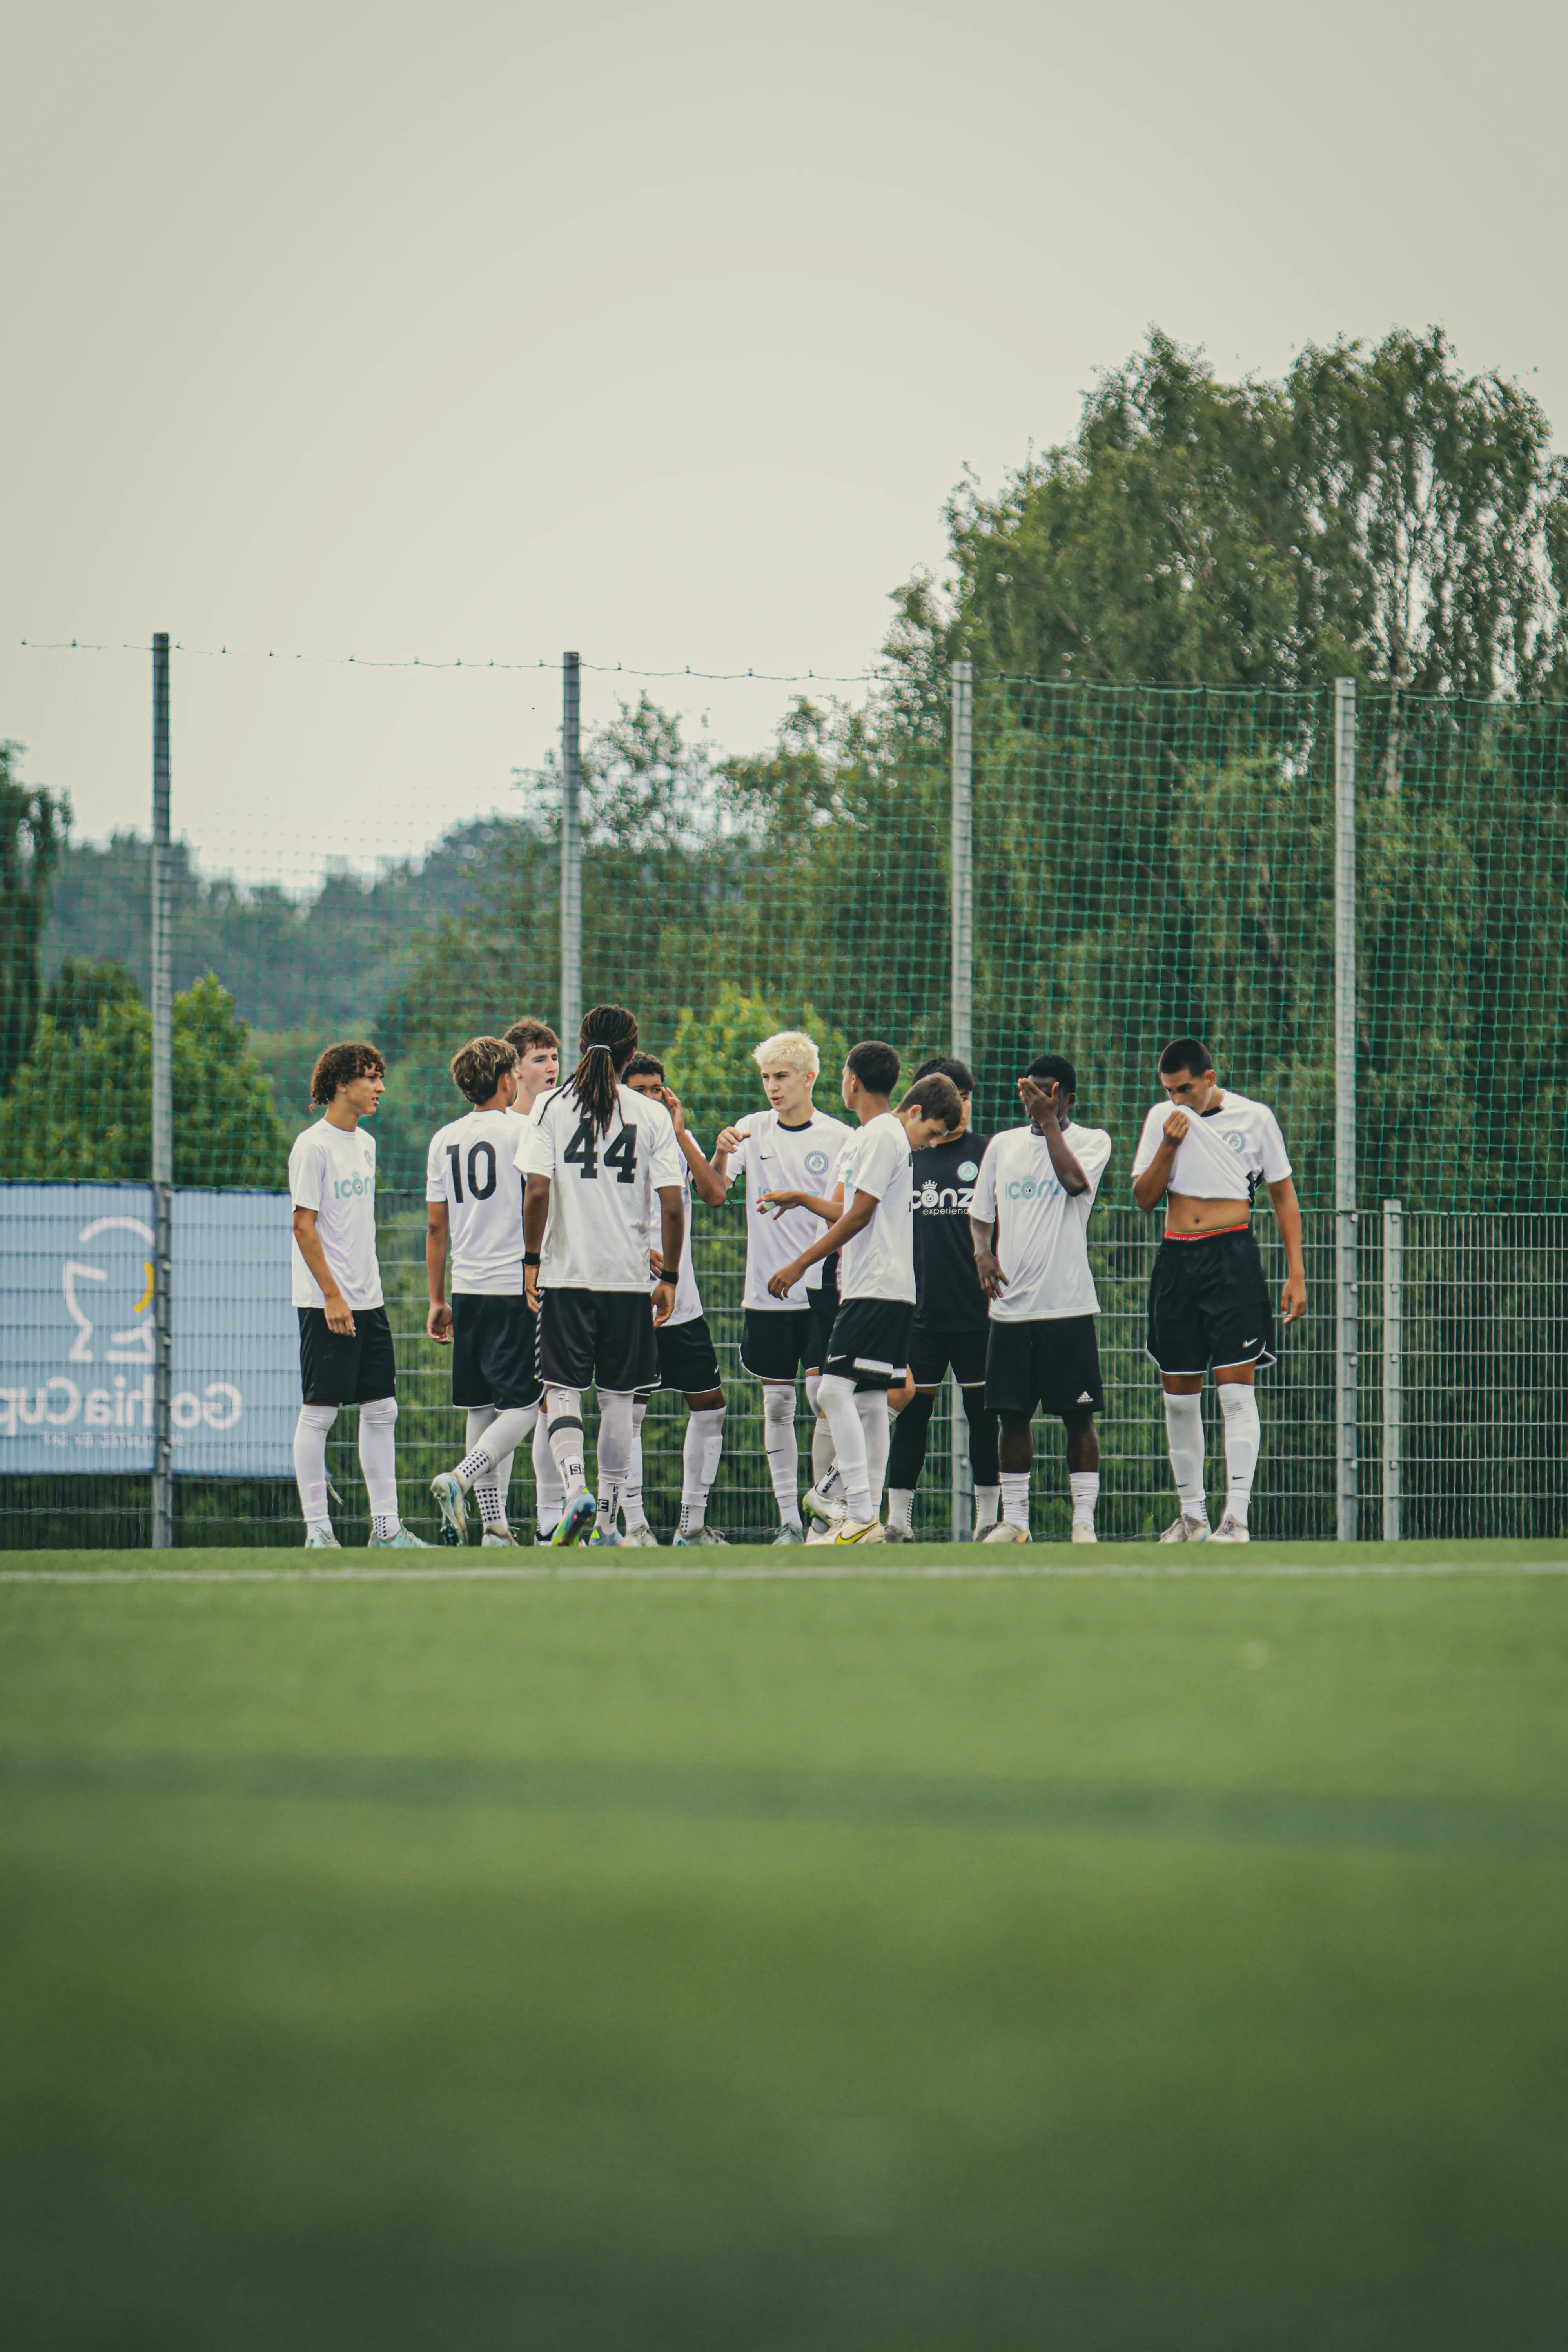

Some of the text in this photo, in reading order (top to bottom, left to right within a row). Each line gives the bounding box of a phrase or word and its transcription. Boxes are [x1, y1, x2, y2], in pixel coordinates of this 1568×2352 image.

[446, 1141, 496, 1203] 10
[564, 1118, 637, 1183] 44
[923, 1207, 969, 1216] experienc
